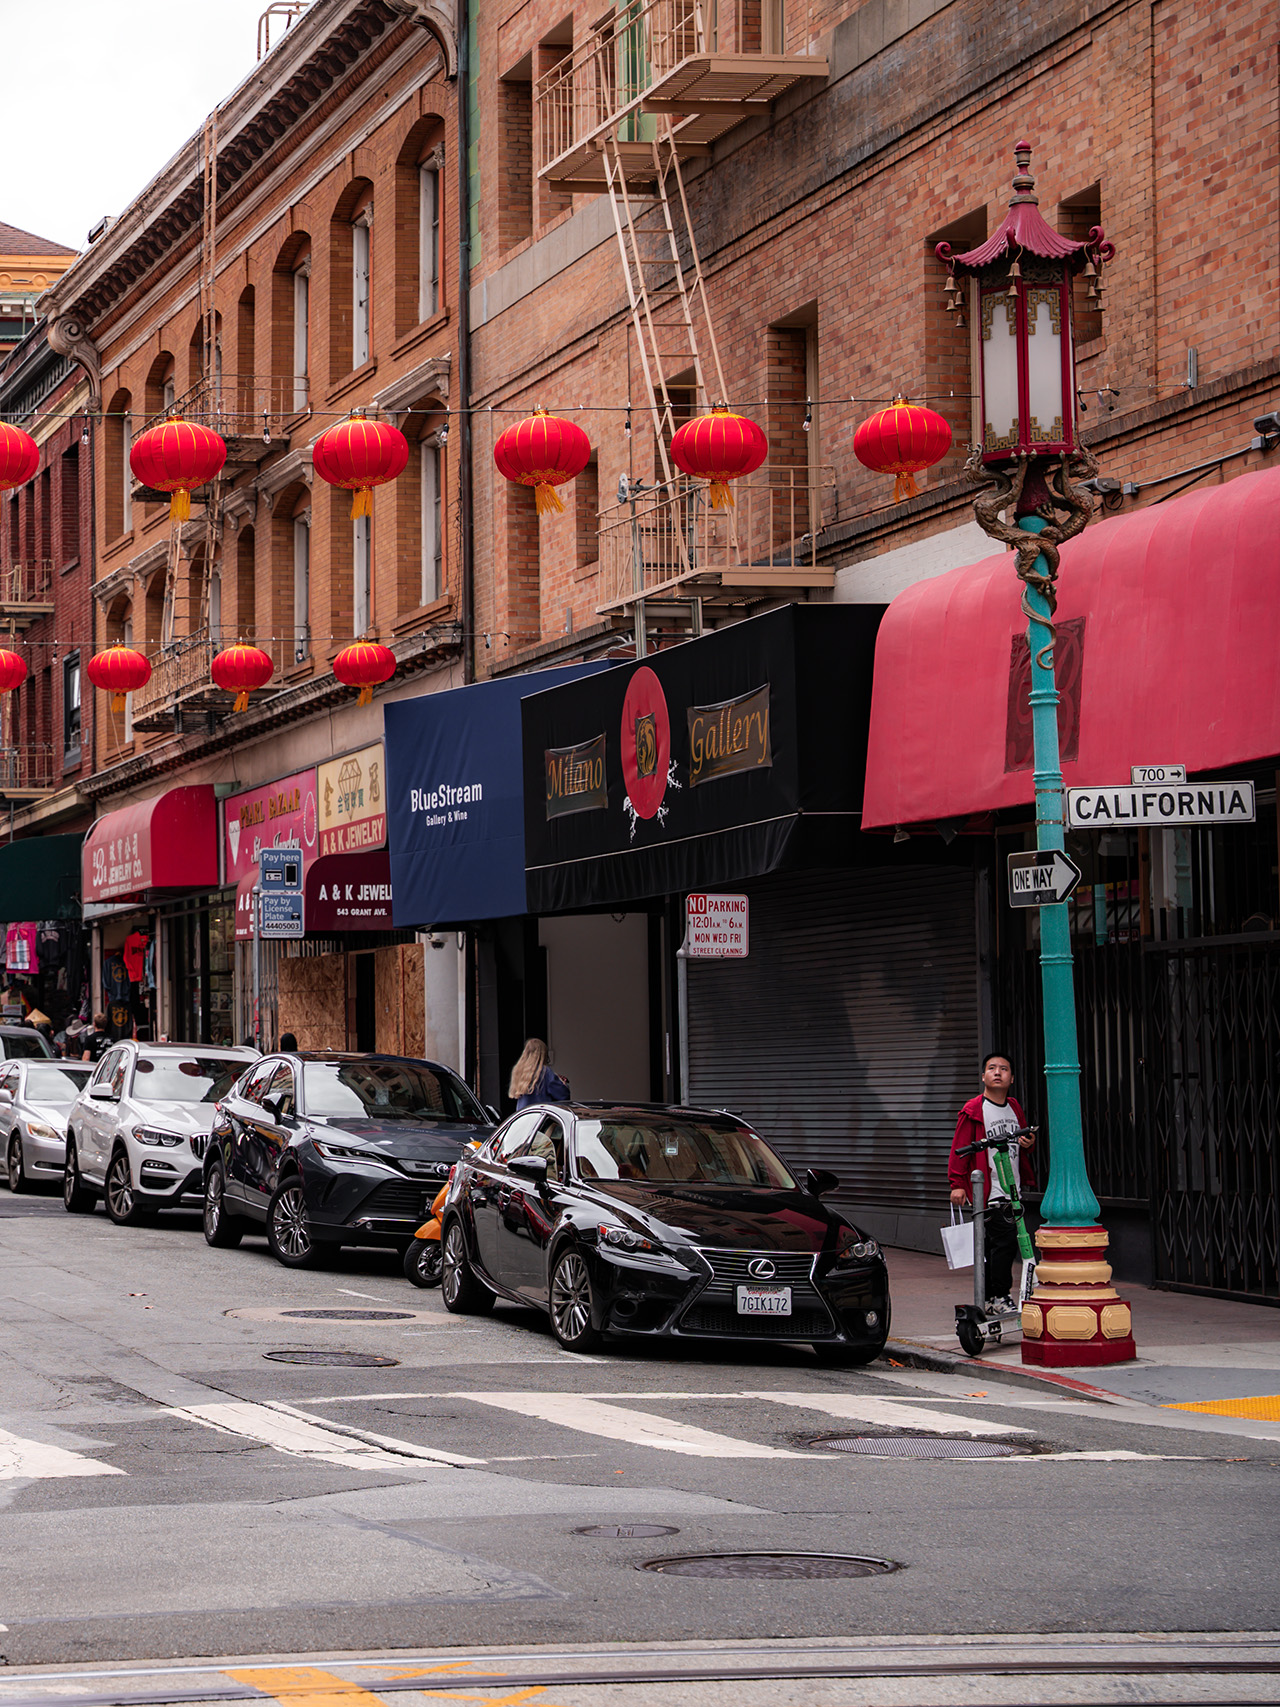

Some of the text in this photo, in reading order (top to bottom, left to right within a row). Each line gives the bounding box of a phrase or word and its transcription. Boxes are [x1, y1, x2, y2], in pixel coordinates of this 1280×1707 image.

[691, 702, 769, 775] Gallery
[547, 749, 603, 800] Milano
[1139, 768, 1165, 781] 700
[410, 783, 483, 813] BlueStream
[1075, 790, 1247, 820] CALIFORNIA
[240, 788, 301, 829] PEARL BAZAAR
[426, 810, 468, 827] Gallery & Wine
[323, 818, 383, 855] A & K JEWELRY
[263, 853, 300, 863] Pay here
[108, 861, 133, 885] JEWELRY
[133, 859, 143, 878] CO.
[1014, 867, 1054, 891] ONE WAY
[319, 884, 328, 901] A
[332, 884, 340, 901] &
[345, 884, 353, 901] K
[264, 896, 291, 907] Pay by
[264, 905, 293, 913] License
[689, 896, 746, 913] NO PARKING
[264, 912, 285, 920] Plate
[337, 908, 388, 916] 543 GRANT AVE.
[265, 922, 300, 930] 44405003
[694, 933, 741, 943] MON WED FRI
[715, 947, 743, 955] CLEANING
[740, 1296, 788, 1312] 7GIK172
